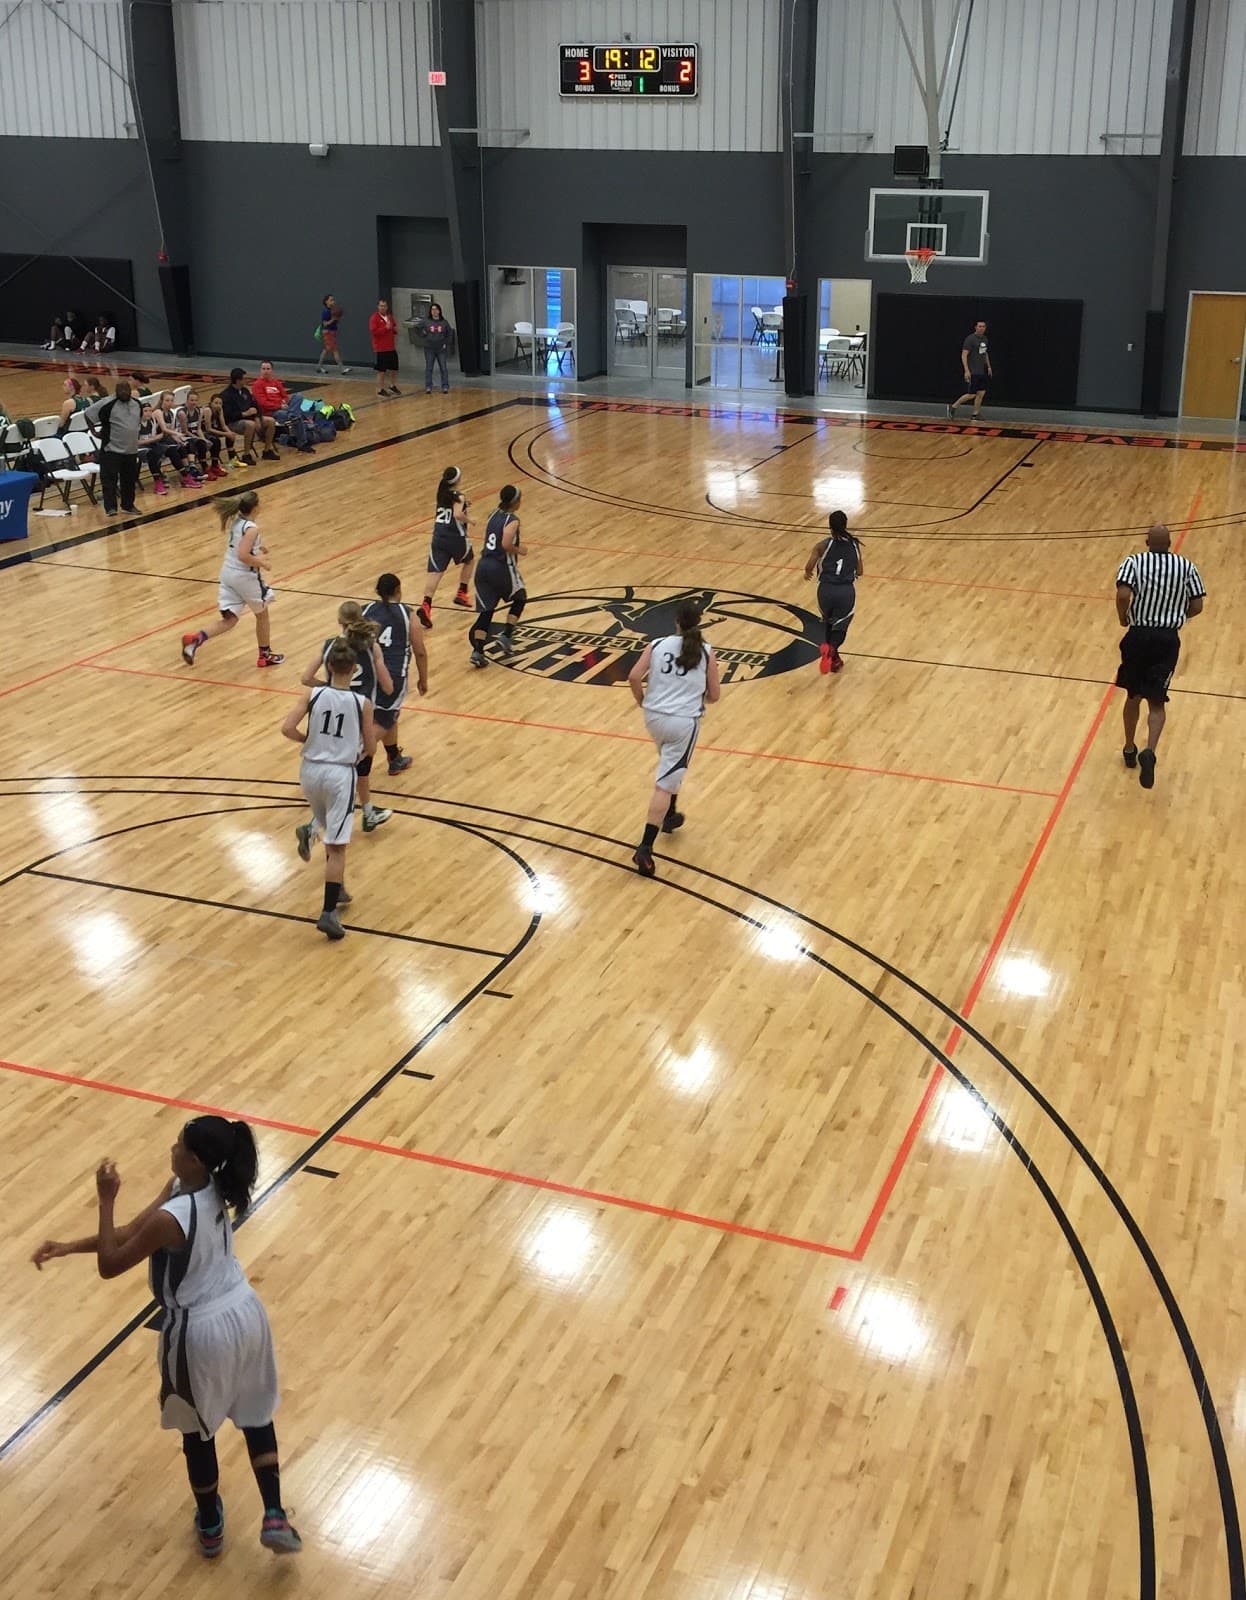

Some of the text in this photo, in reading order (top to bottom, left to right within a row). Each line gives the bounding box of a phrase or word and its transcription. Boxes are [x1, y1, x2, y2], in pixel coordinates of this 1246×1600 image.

[565, 48, 589, 58] HOME
[662, 47, 695, 58] VISITOR
[579, 61, 590, 81] 3
[680, 61, 691, 82] 2
[639, 77, 644, 93] 1
[817, 418, 1004, 437] HOOPS
[1021, 431, 1203, 449] LEVEL
[435, 507, 452, 524] 20
[486, 533, 497, 551] 9
[835, 558, 844, 576] 1
[379, 626, 393, 648] 4
[319, 710, 345, 739] 11
